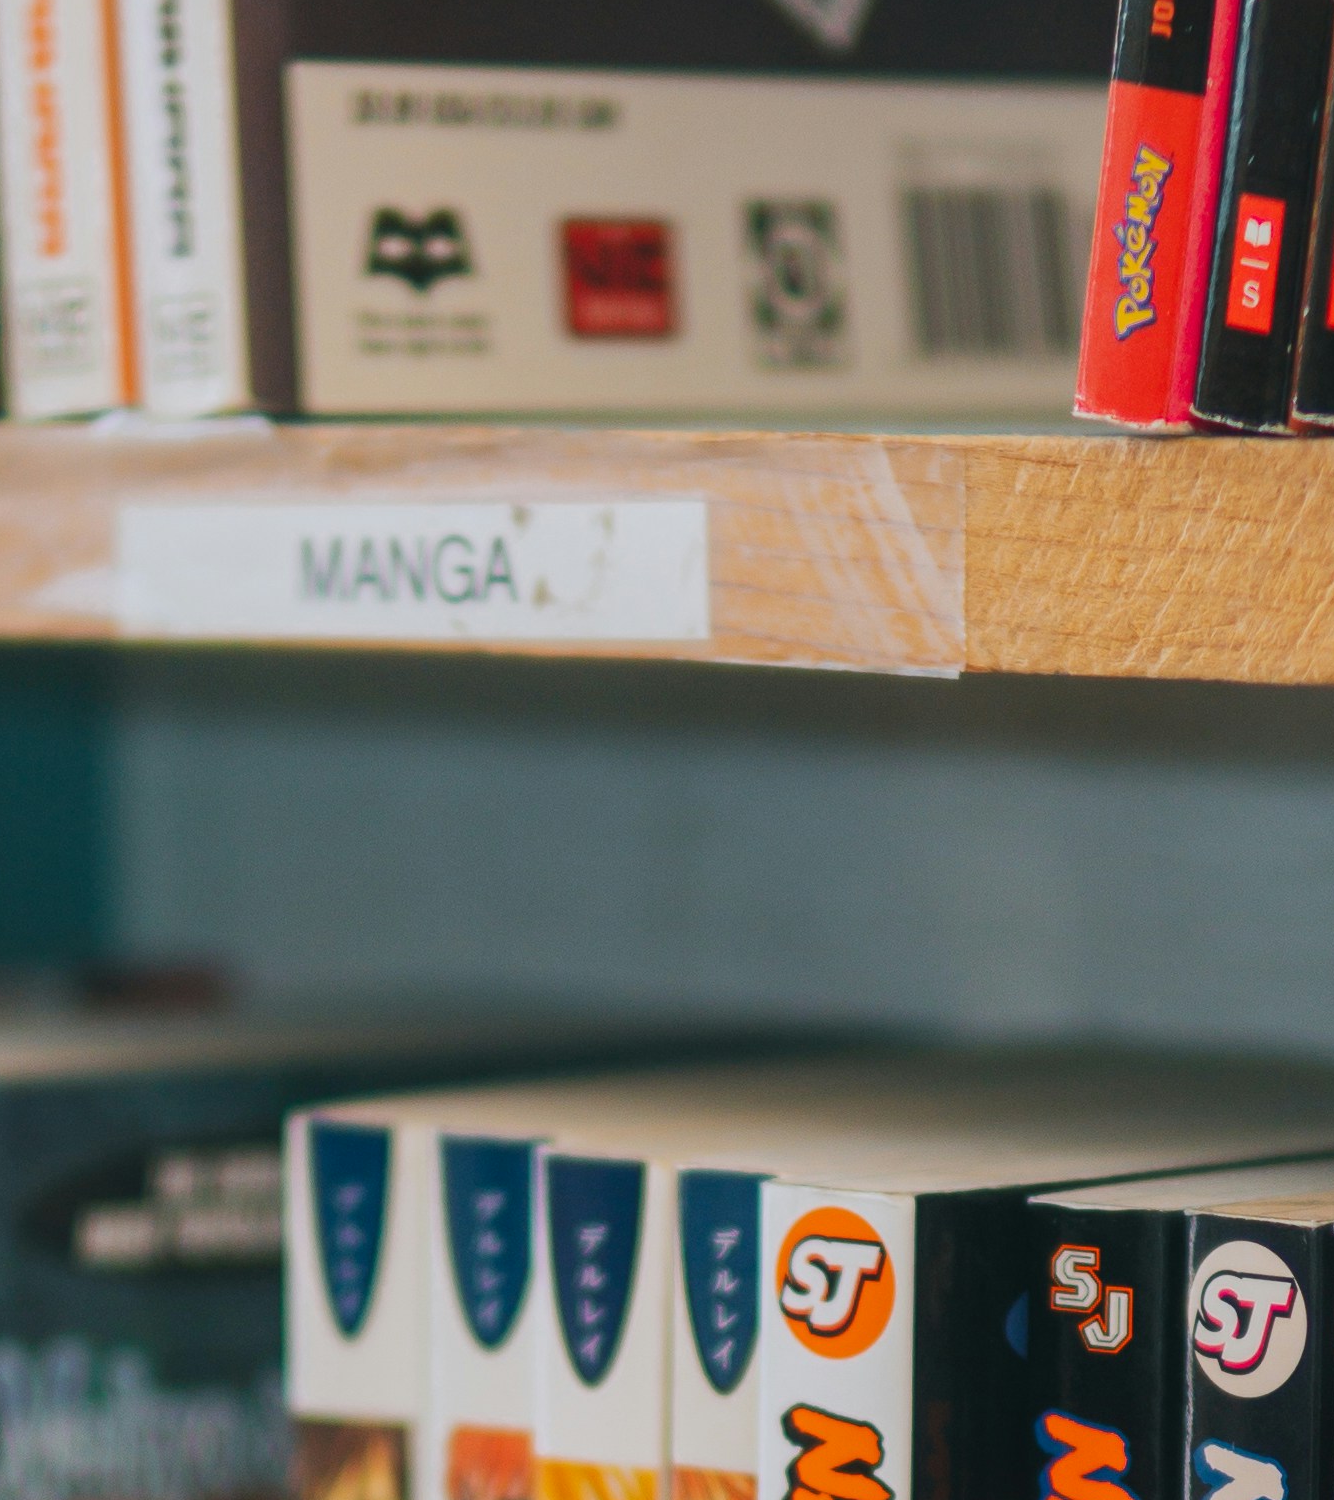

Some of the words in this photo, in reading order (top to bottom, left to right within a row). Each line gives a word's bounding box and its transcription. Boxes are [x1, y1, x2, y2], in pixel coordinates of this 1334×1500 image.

[1112, 143, 1174, 340] Pokémon
[301, 533, 519, 603] MANGA
[712, 1228, 740, 1369] デルレイ
[1053, 1246, 1132, 1355] SJ
